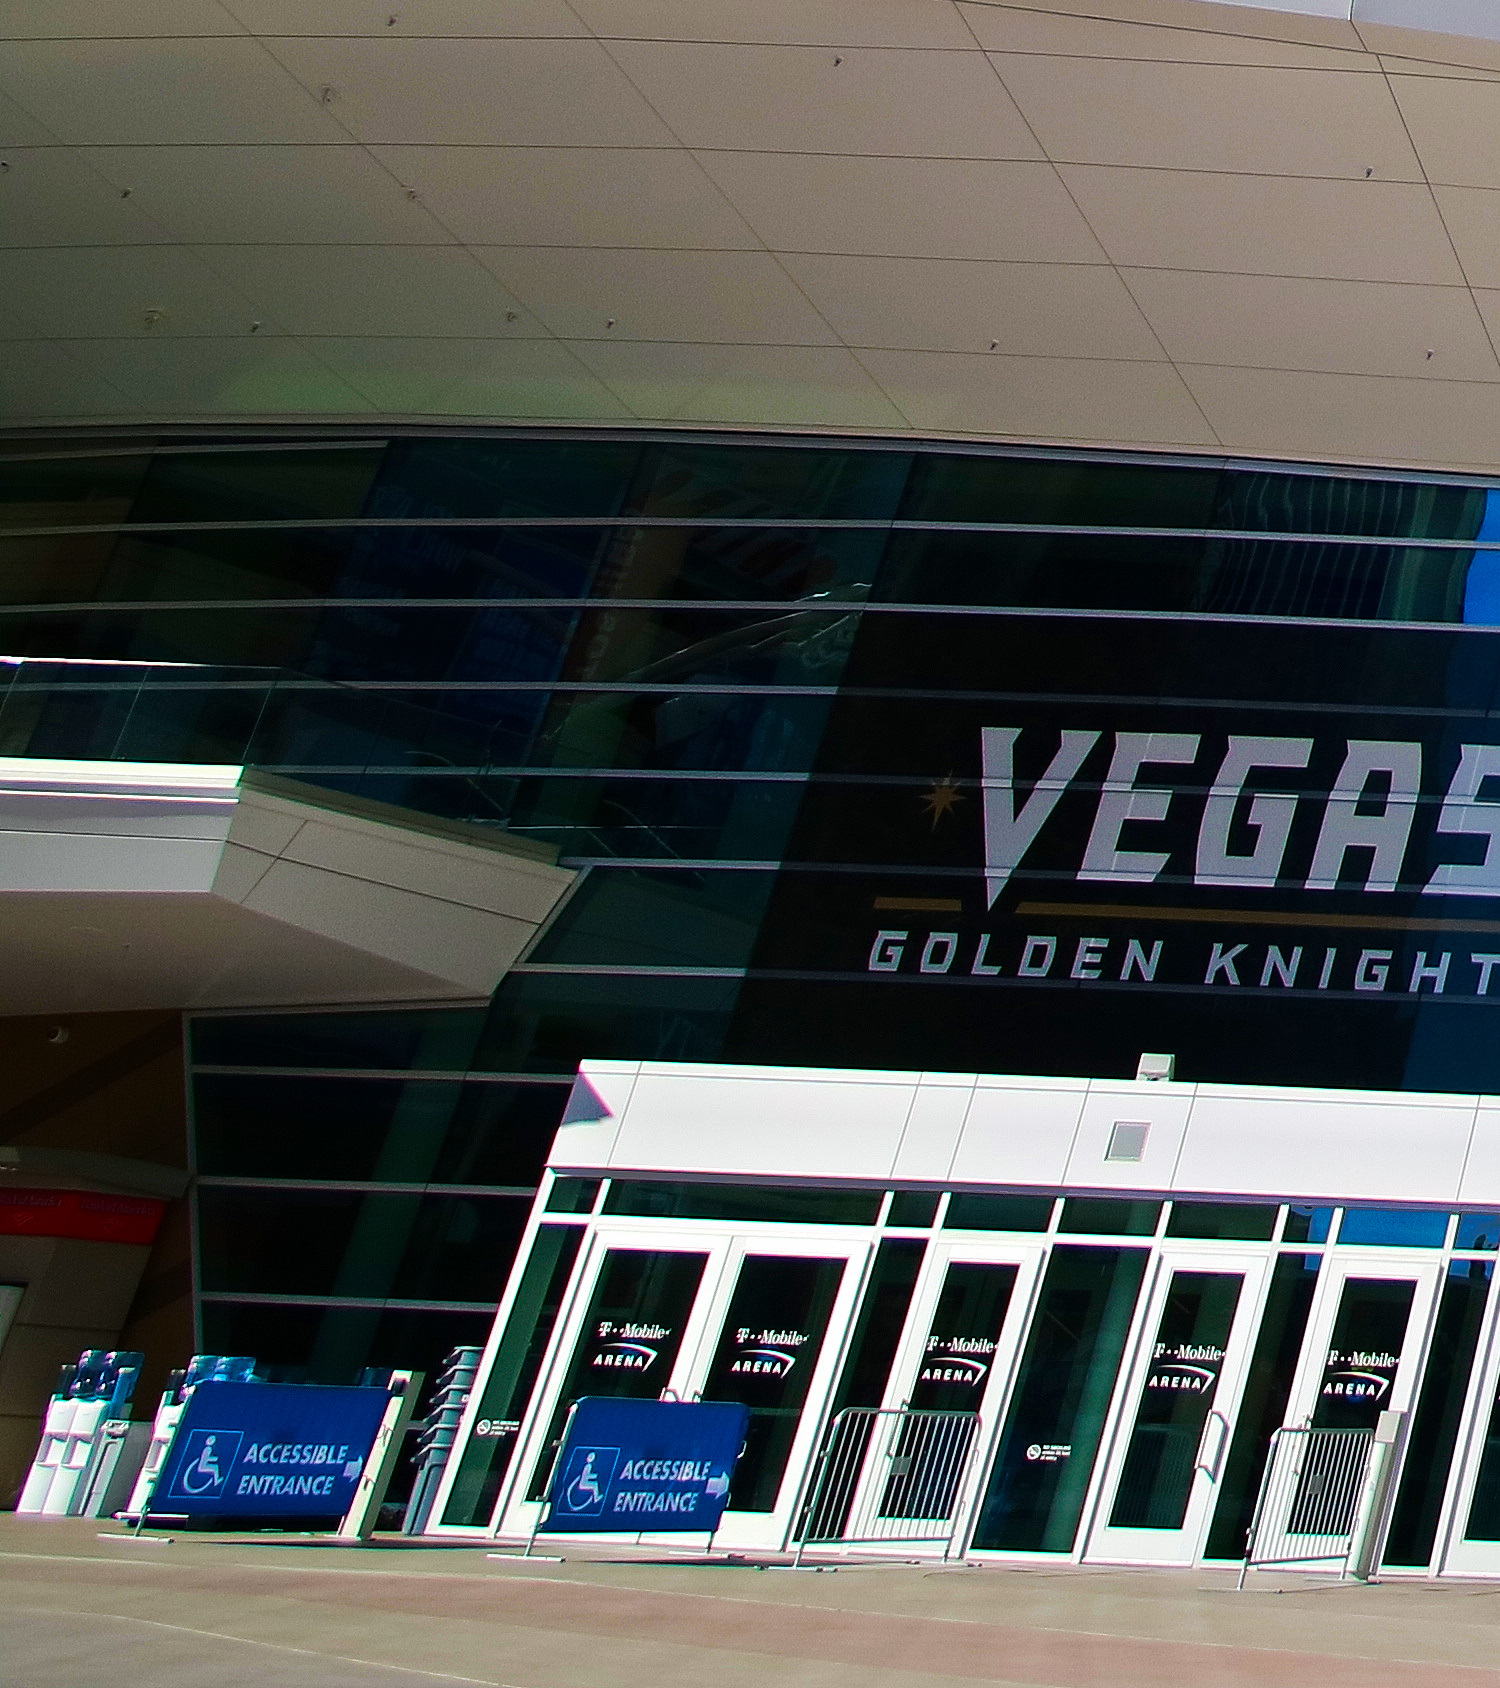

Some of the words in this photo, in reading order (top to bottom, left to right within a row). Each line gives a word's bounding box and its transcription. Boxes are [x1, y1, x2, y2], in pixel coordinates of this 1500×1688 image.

[868, 928, 1164, 984] GOLDEN
[593, 1353, 644, 1368] ARENA
[731, 1360, 782, 1374] ARENA
[921, 1367, 973, 1382] ARENA
[1148, 1374, 1201, 1389] ARENA
[1323, 1382, 1376, 1396] ARENA
[242, 1442, 350, 1465] ACCESSIBLE
[619, 1459, 712, 1481] ACCESSIBLE
[236, 1474, 336, 1496] ENTRANCE
[613, 1491, 699, 1512] ENTRANCE
